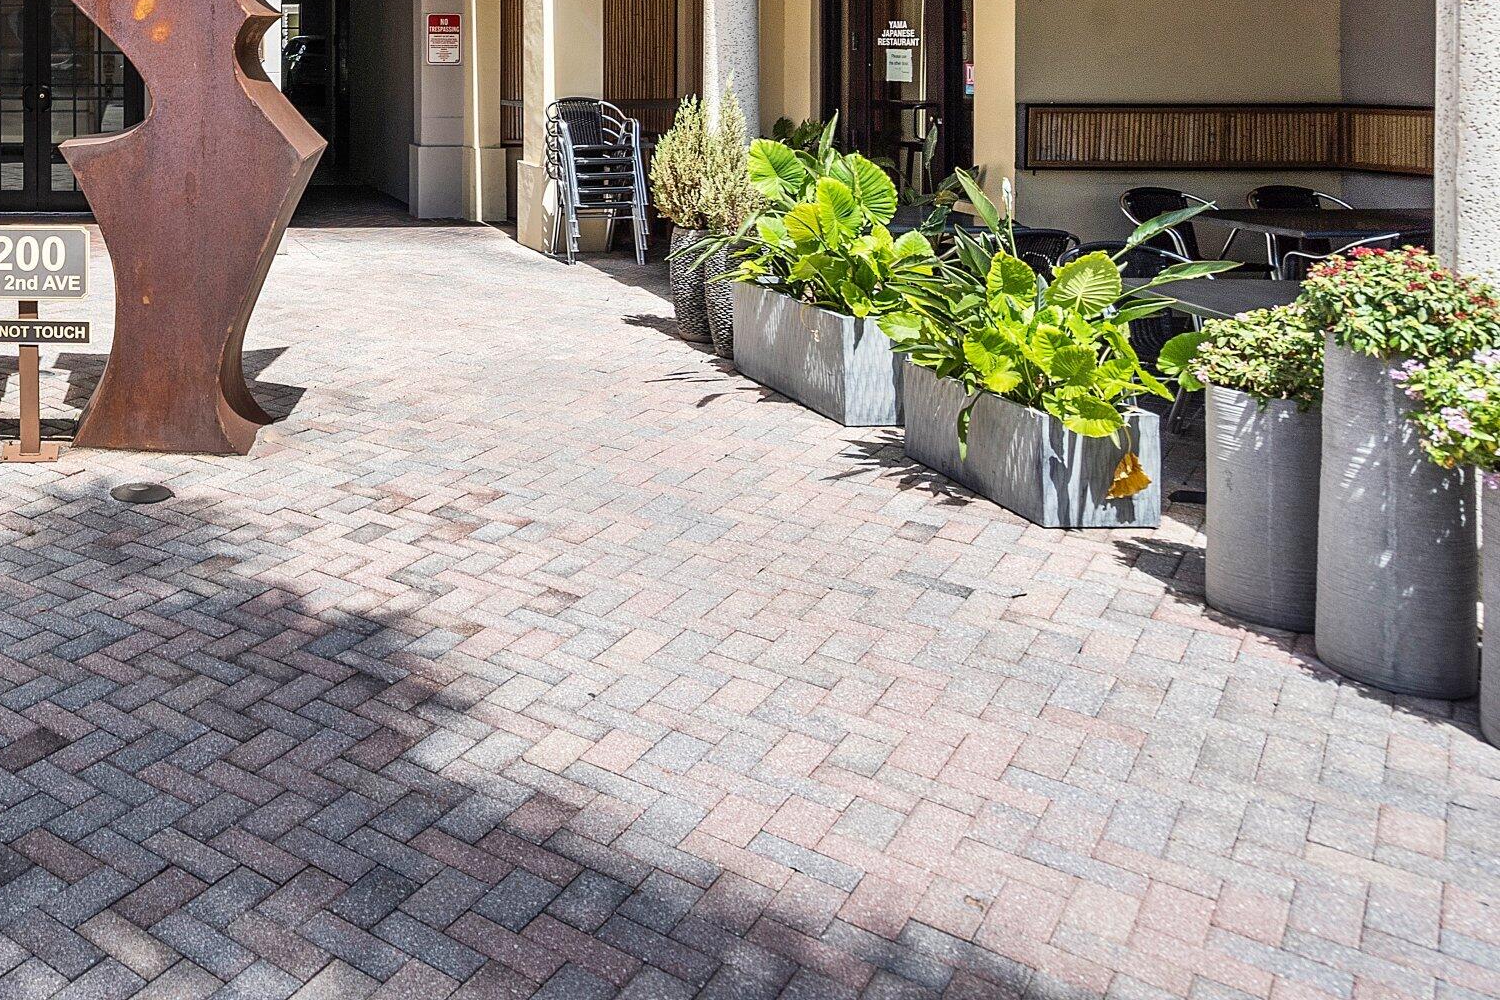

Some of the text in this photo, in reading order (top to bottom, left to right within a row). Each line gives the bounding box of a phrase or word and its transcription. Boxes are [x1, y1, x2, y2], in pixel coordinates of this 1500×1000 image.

[440, 18, 449, 26] NO
[888, 20, 908, 29] YAMA
[881, 29, 916, 38] JAPANESE
[877, 37, 920, 47] RESTAURANT
[4, 274, 38, 291] 2nd
[42, 275, 81, 291] AVE
[32, 326, 86, 340] TOUCH
